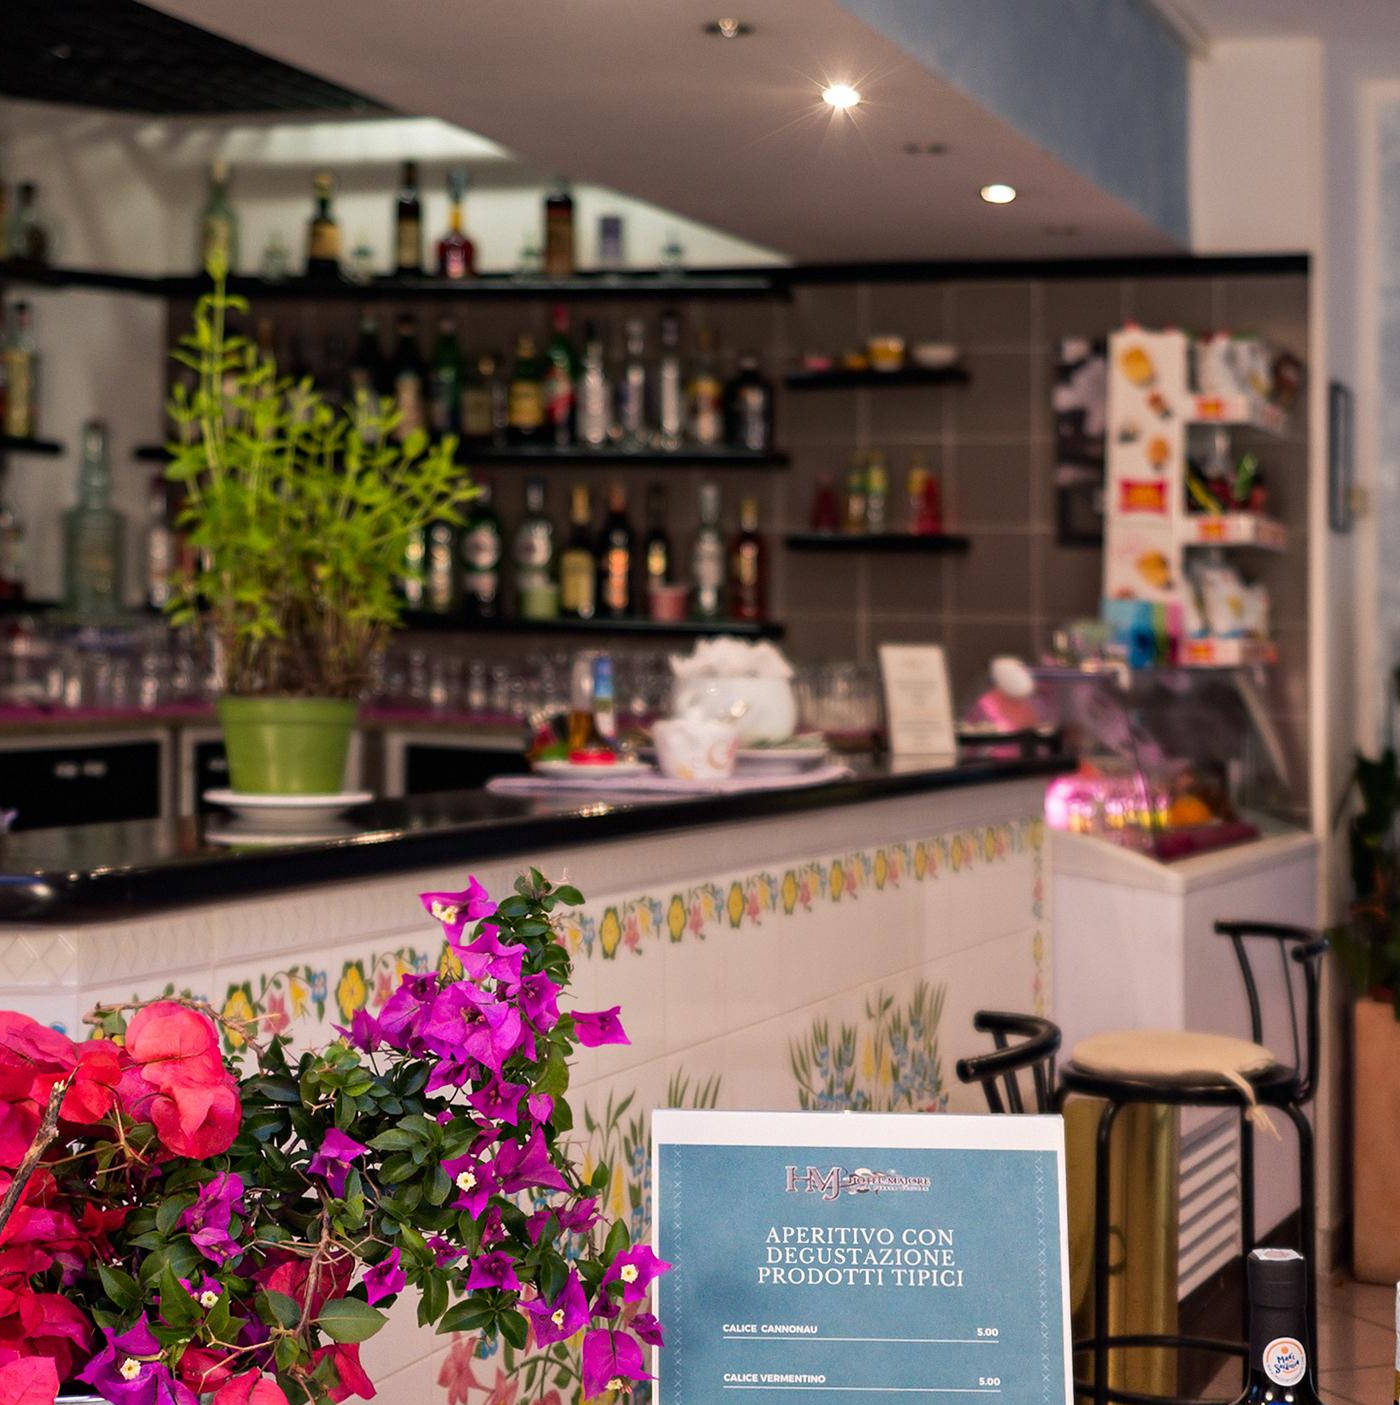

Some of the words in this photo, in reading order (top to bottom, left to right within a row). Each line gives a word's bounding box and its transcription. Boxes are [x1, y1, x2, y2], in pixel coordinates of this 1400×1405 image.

[766, 1226, 894, 1245] APERITIVO
[902, 1228, 954, 1246] CON
[766, 1246, 955, 1267] DEGUSTAZIONE
[758, 1266, 883, 1286] PRODOTTI
[891, 1269, 964, 1287] TIPICI
[723, 1323, 757, 1333] CALICE
[761, 1324, 818, 1334] CANNONAU
[976, 1327, 999, 1337] 5.00
[723, 1373, 758, 1383] CALICE
[760, 1373, 826, 1384] VERMENTINO
[978, 1377, 1001, 1387] 5.00
